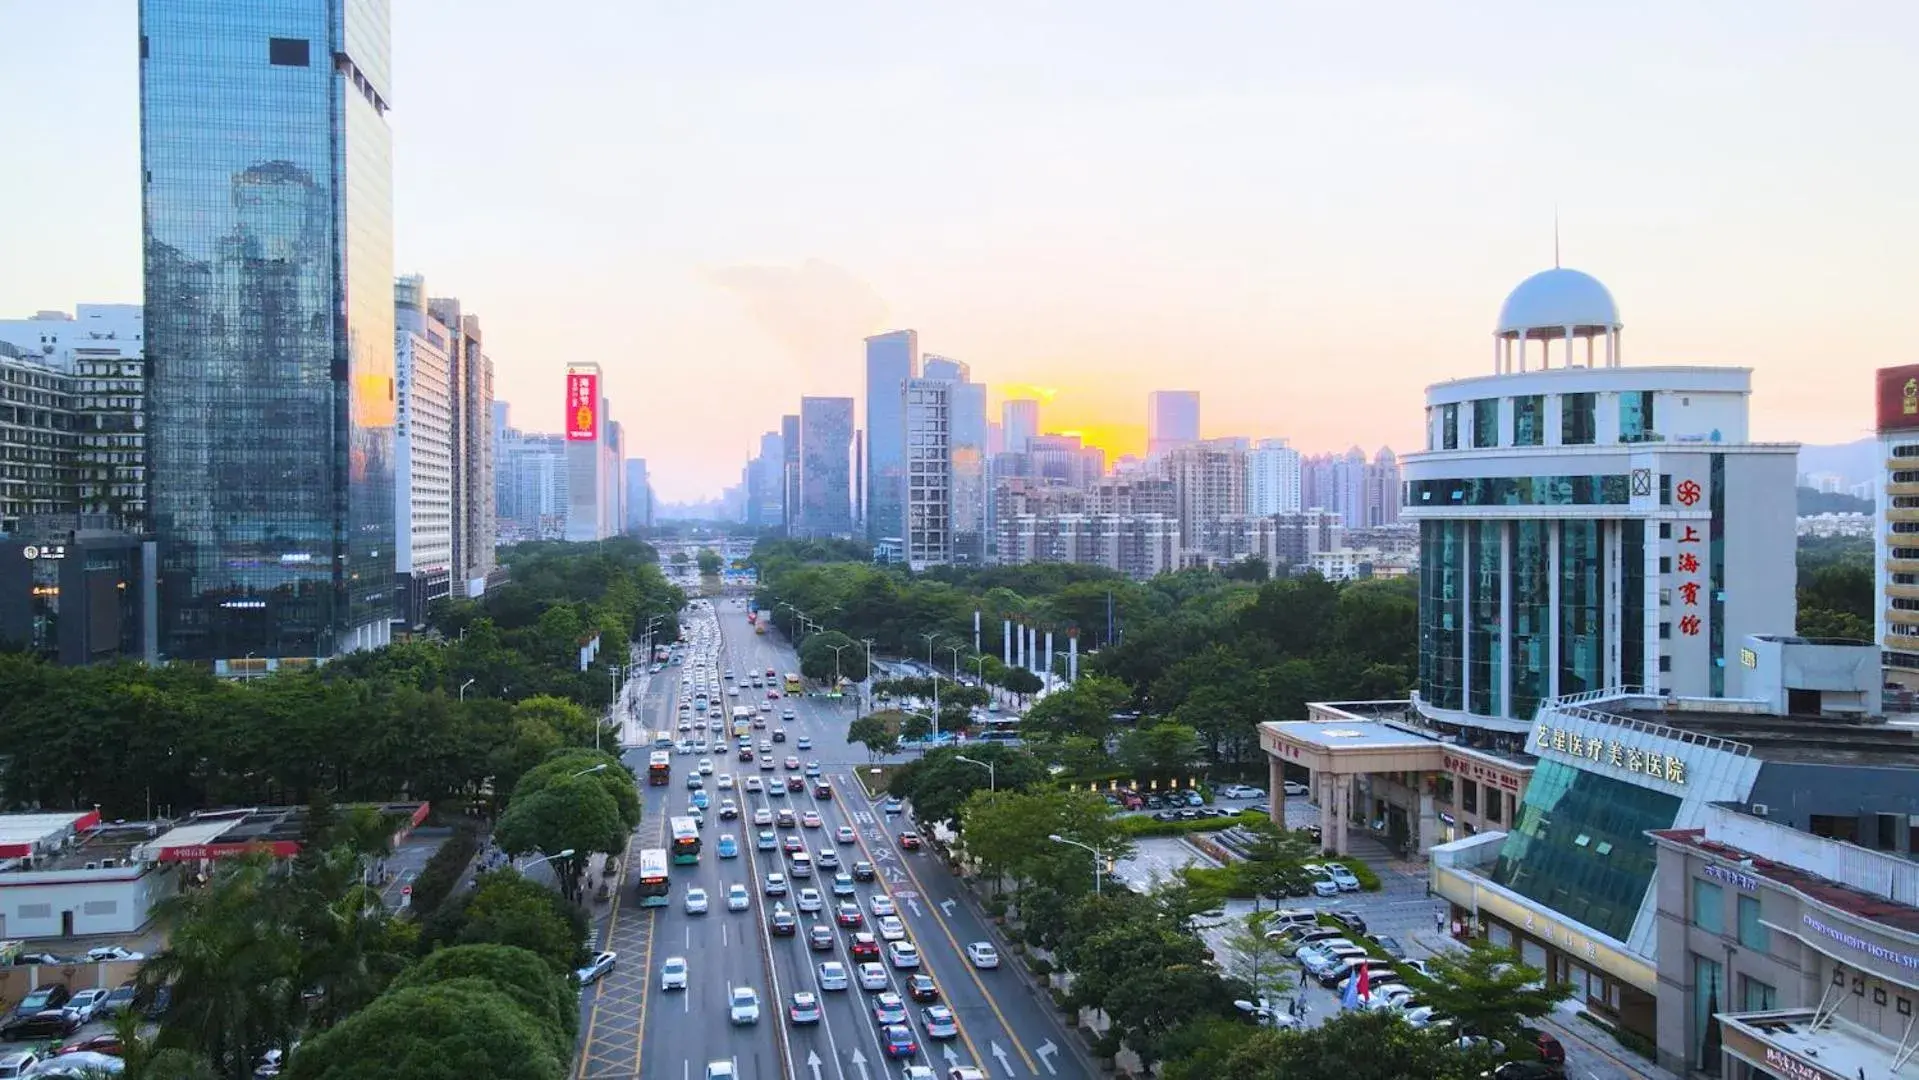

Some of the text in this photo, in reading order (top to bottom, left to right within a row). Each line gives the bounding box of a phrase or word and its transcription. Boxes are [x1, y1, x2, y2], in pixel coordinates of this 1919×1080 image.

[1678, 525, 1701, 636] 上海宾馆
[1536, 723, 1685, 784] 艺星医疗美容医院
[1868, 941, 1901, 963] HOTEL
